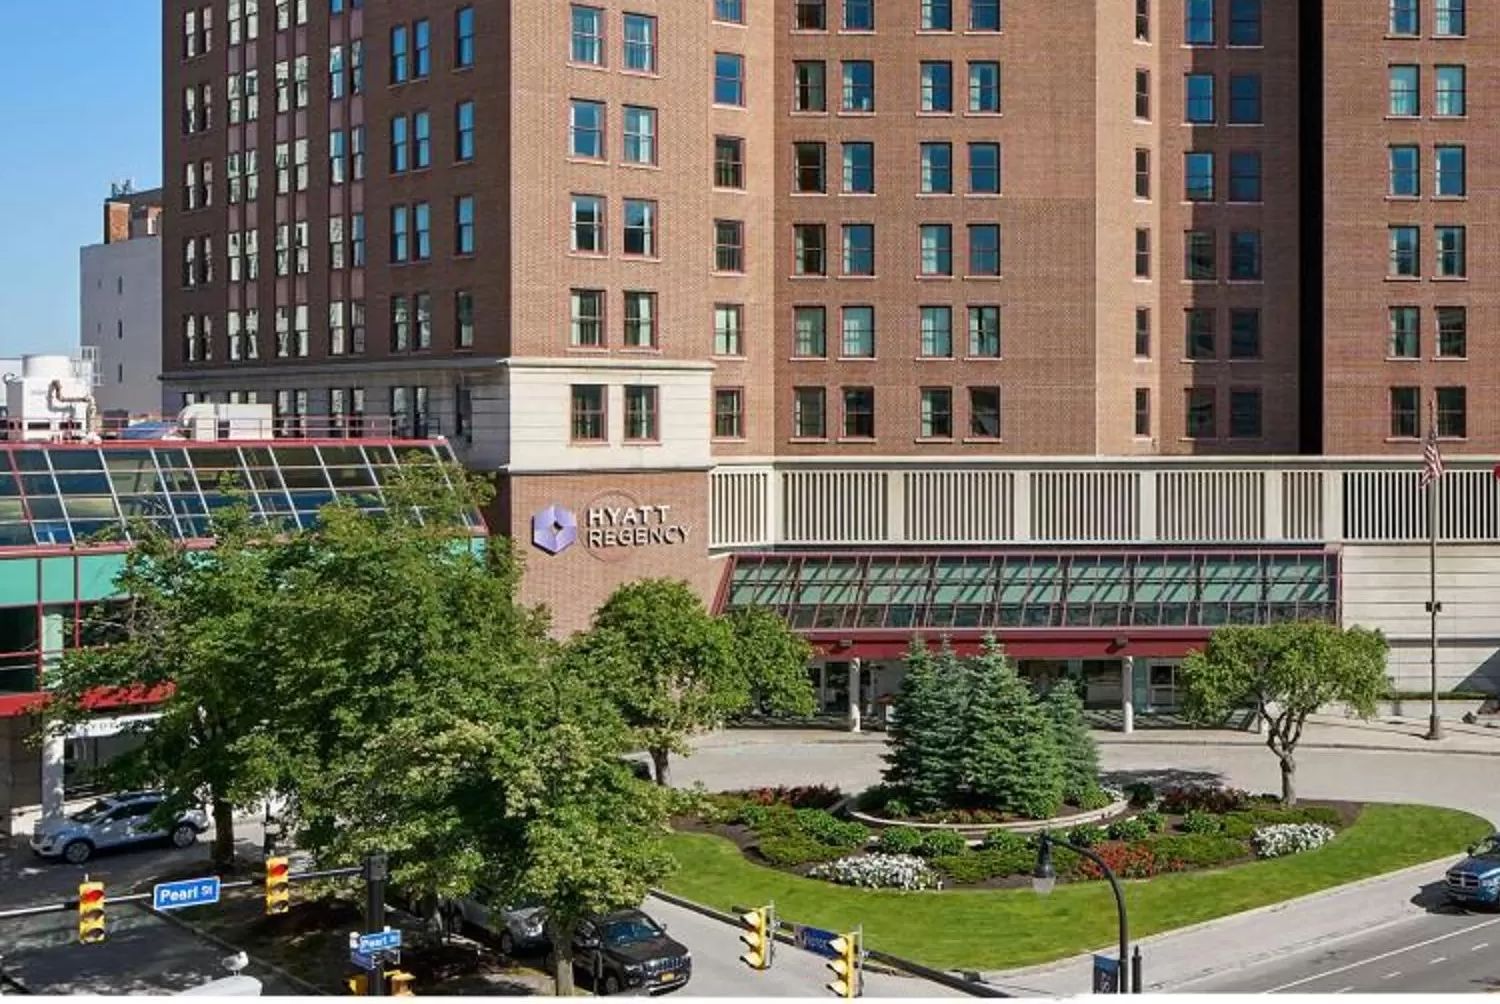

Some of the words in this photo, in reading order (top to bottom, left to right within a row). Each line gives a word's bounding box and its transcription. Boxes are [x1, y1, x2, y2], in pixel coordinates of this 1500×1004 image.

[588, 505, 671, 527] HYATT
[588, 525, 691, 547] REGENCY
[160, 886, 199, 903] Pearl
